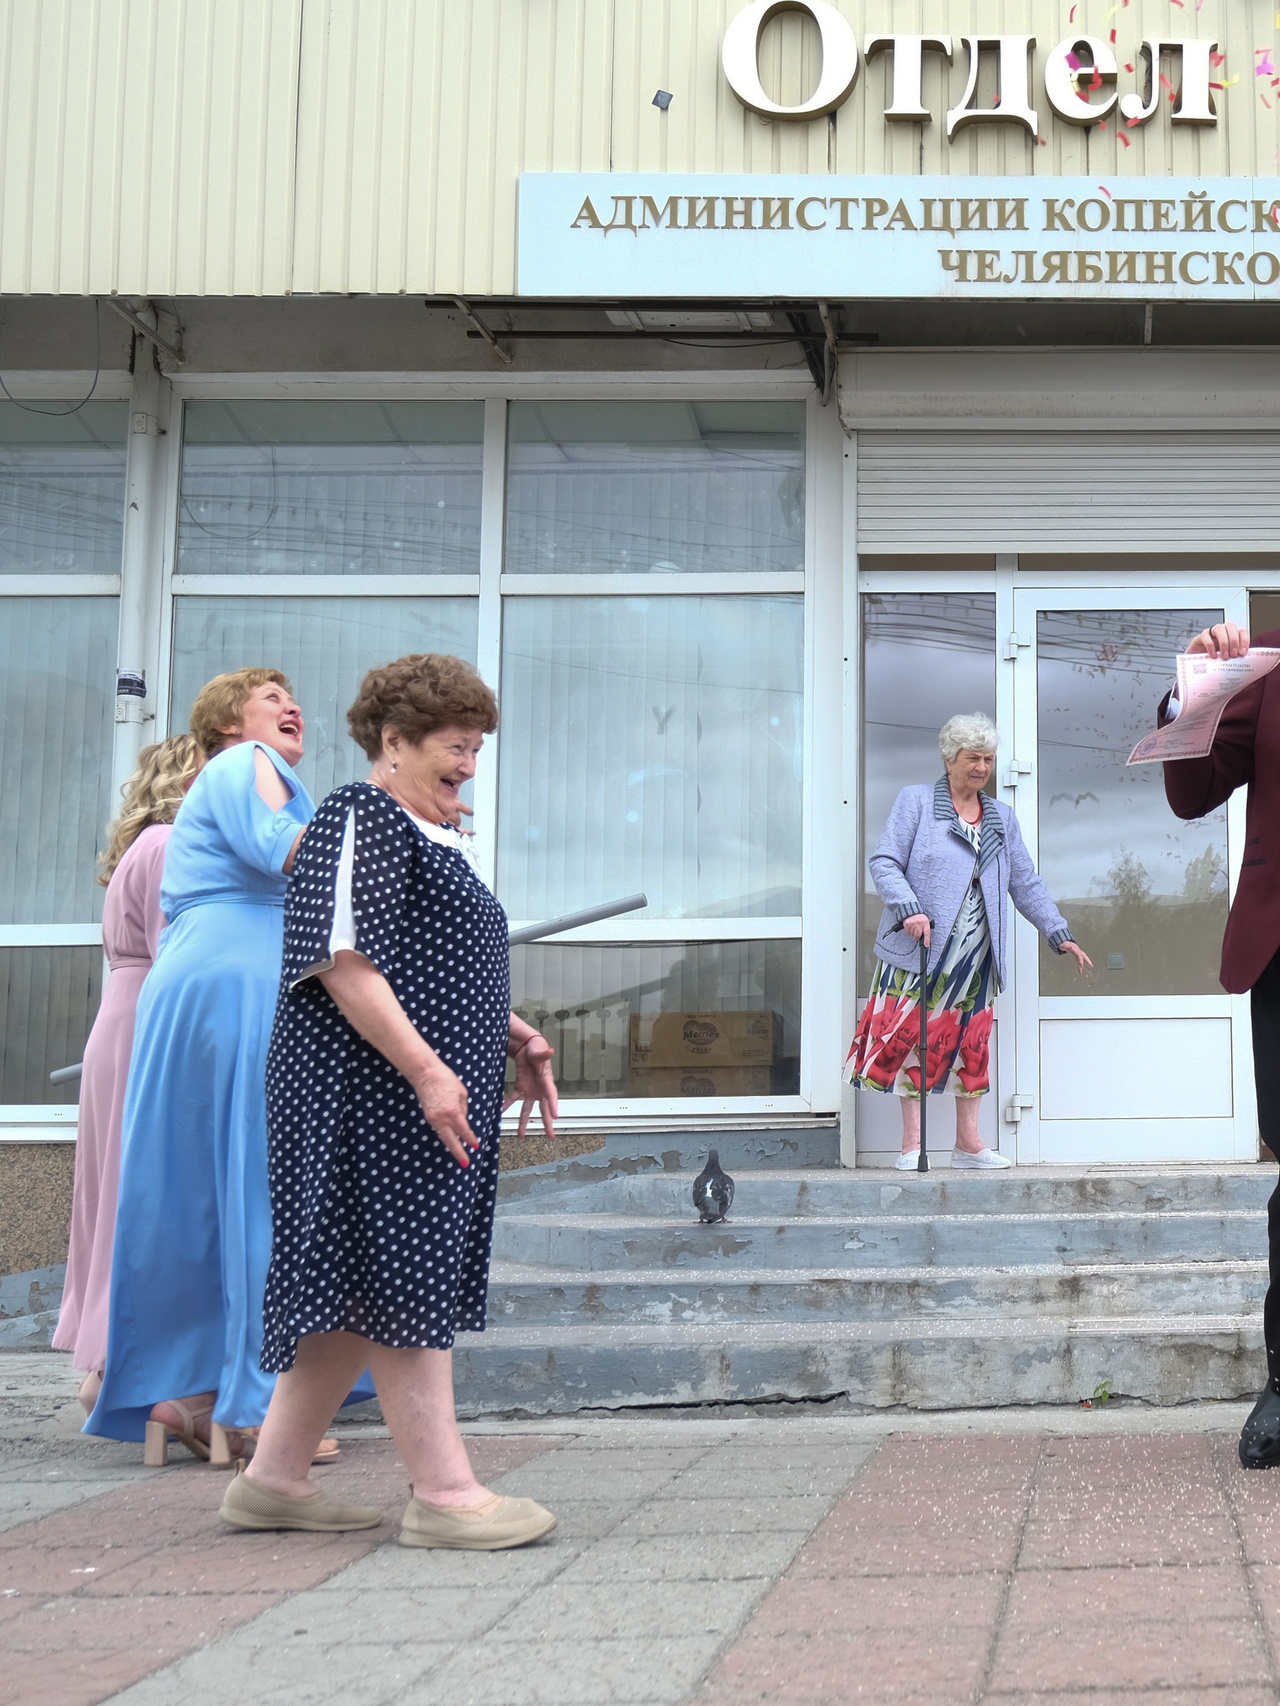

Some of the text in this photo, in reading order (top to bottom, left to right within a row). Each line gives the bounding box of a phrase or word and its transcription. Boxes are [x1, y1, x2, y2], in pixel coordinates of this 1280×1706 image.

[722, 0, 1219, 144] Отдел
[570, 194, 1029, 238] АДМИНИСТРАЦИИ
[683, 1029, 720, 1040] Merries
[680, 1084, 717, 1095] Merries
